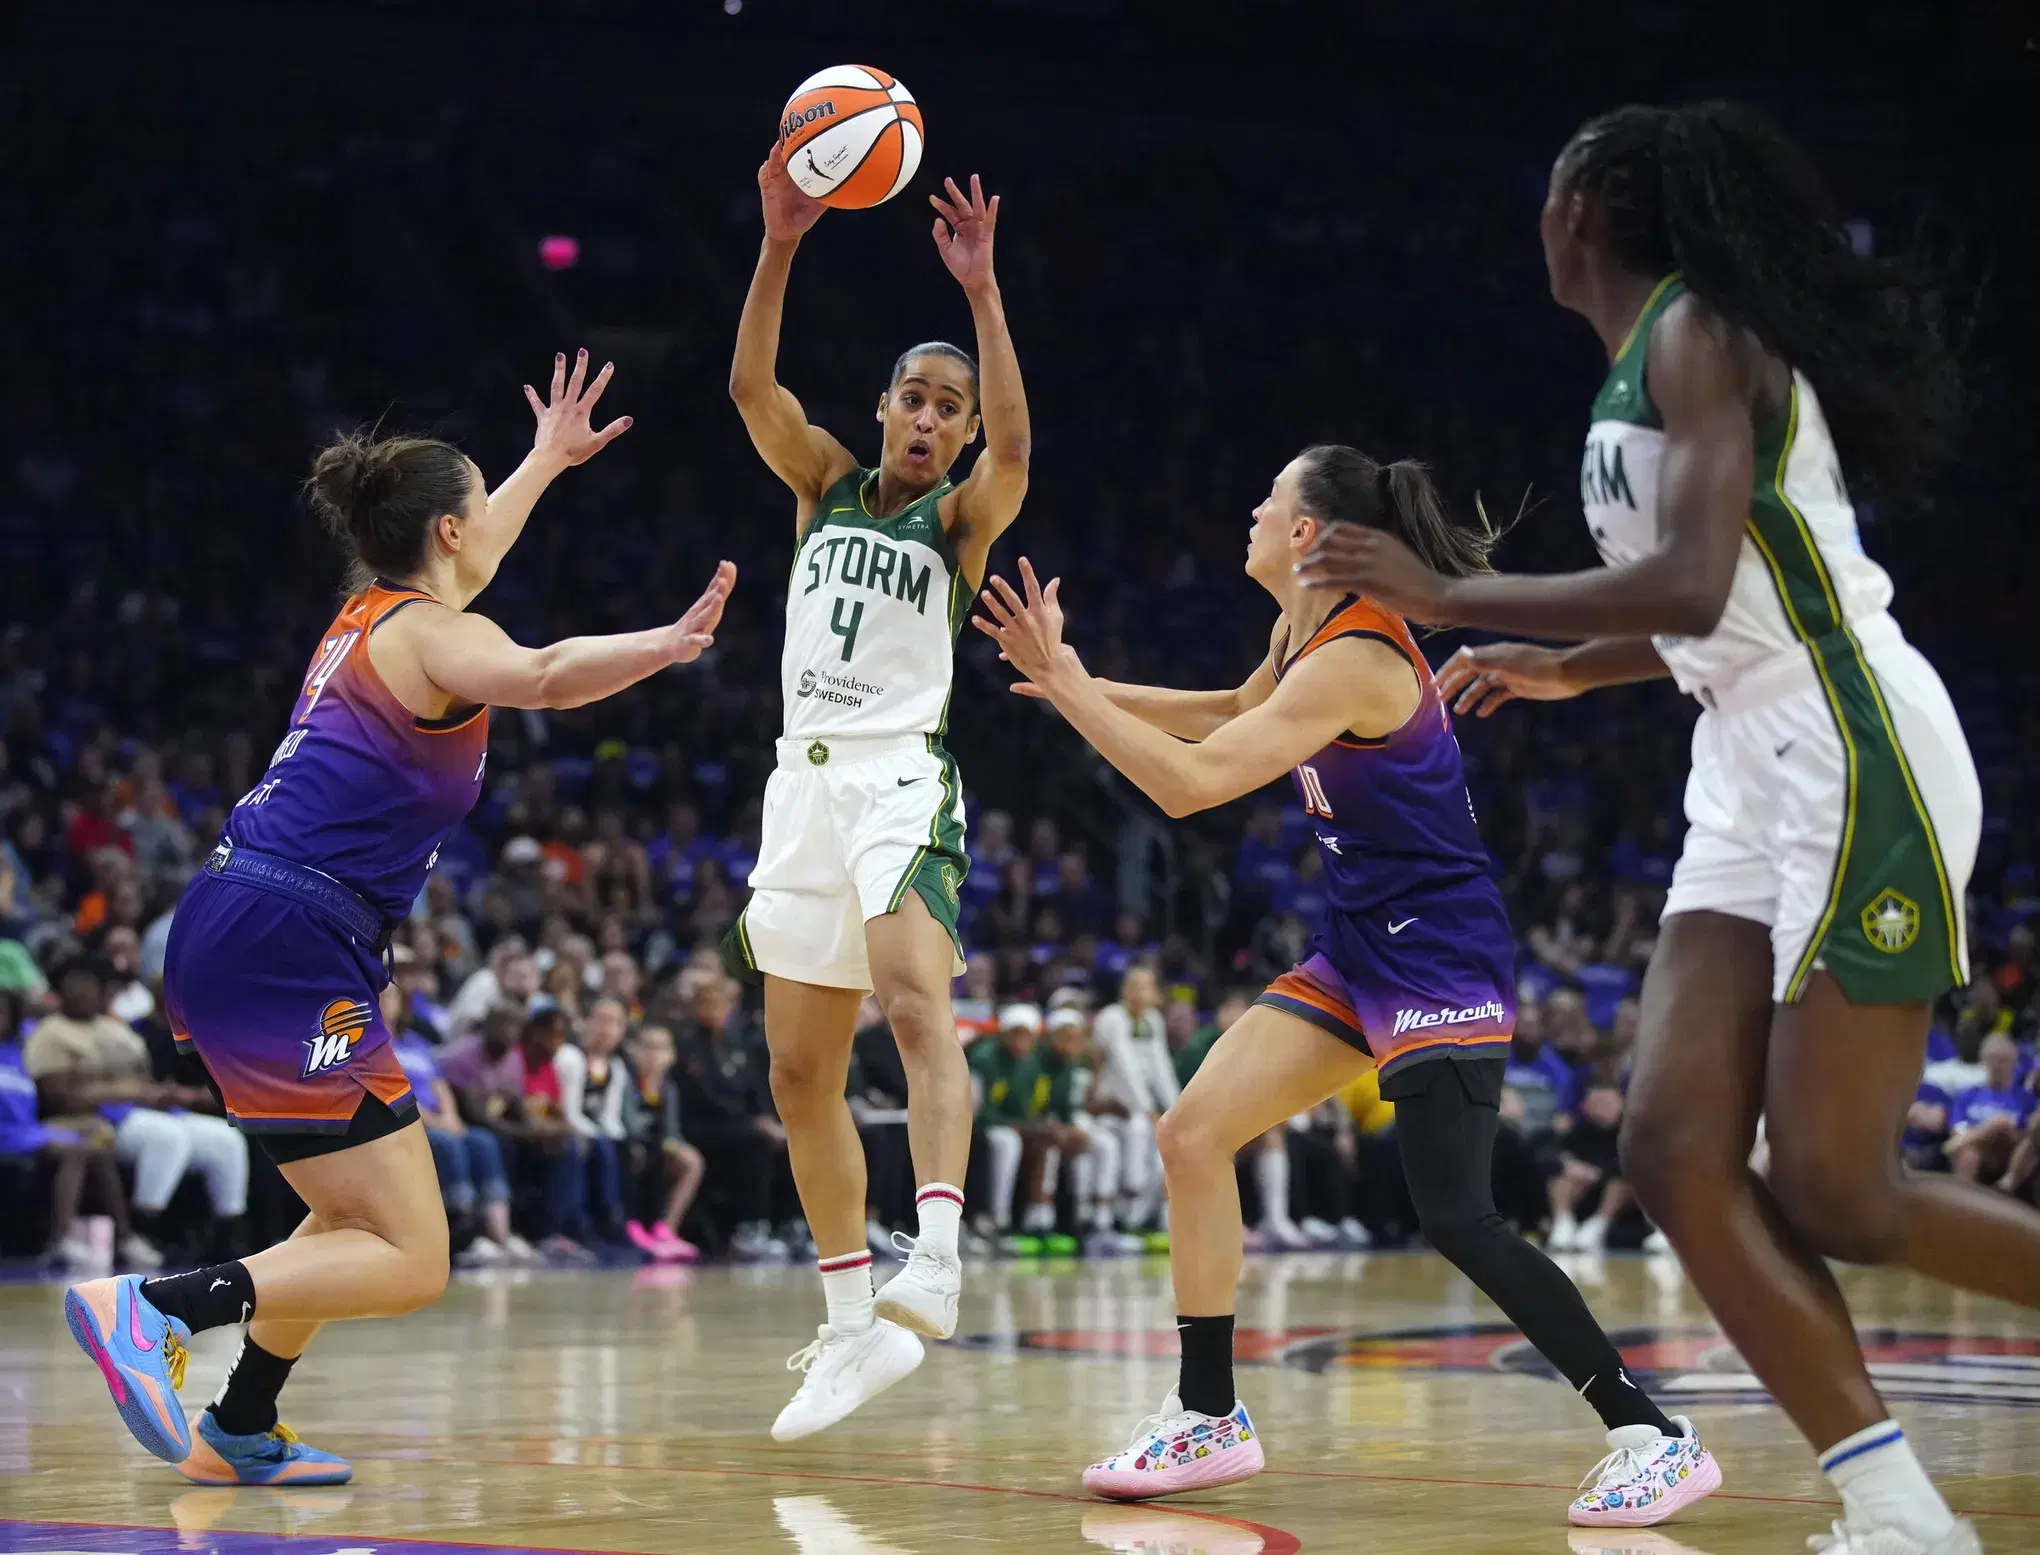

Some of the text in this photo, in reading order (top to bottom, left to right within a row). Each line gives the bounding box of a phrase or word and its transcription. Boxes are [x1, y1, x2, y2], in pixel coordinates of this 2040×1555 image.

[804, 536, 932, 616] STORM
[830, 596, 865, 662] 4
[814, 688, 862, 708] SWEDISH
[821, 670, 884, 696] Providence
[1297, 764, 1333, 819] 10
[1392, 1000, 1504, 1037] Mercury
